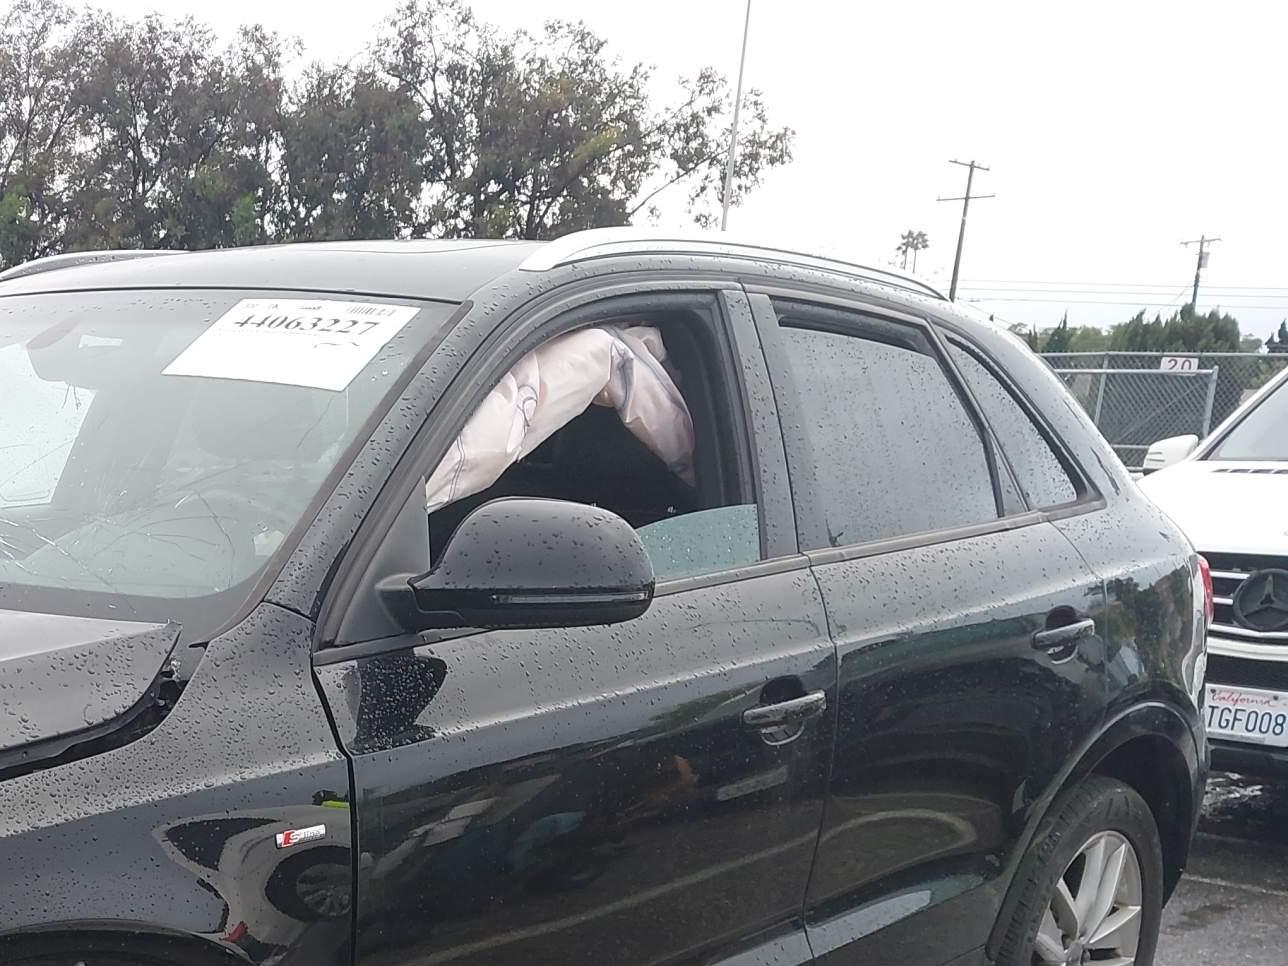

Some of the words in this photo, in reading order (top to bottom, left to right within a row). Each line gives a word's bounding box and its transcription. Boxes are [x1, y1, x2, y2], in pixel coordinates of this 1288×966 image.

[234, 313, 382, 336] 44063227
[1167, 358, 1192, 371] 20
[1211, 690, 1272, 706] California
[1207, 704, 1287, 737] TGF008
